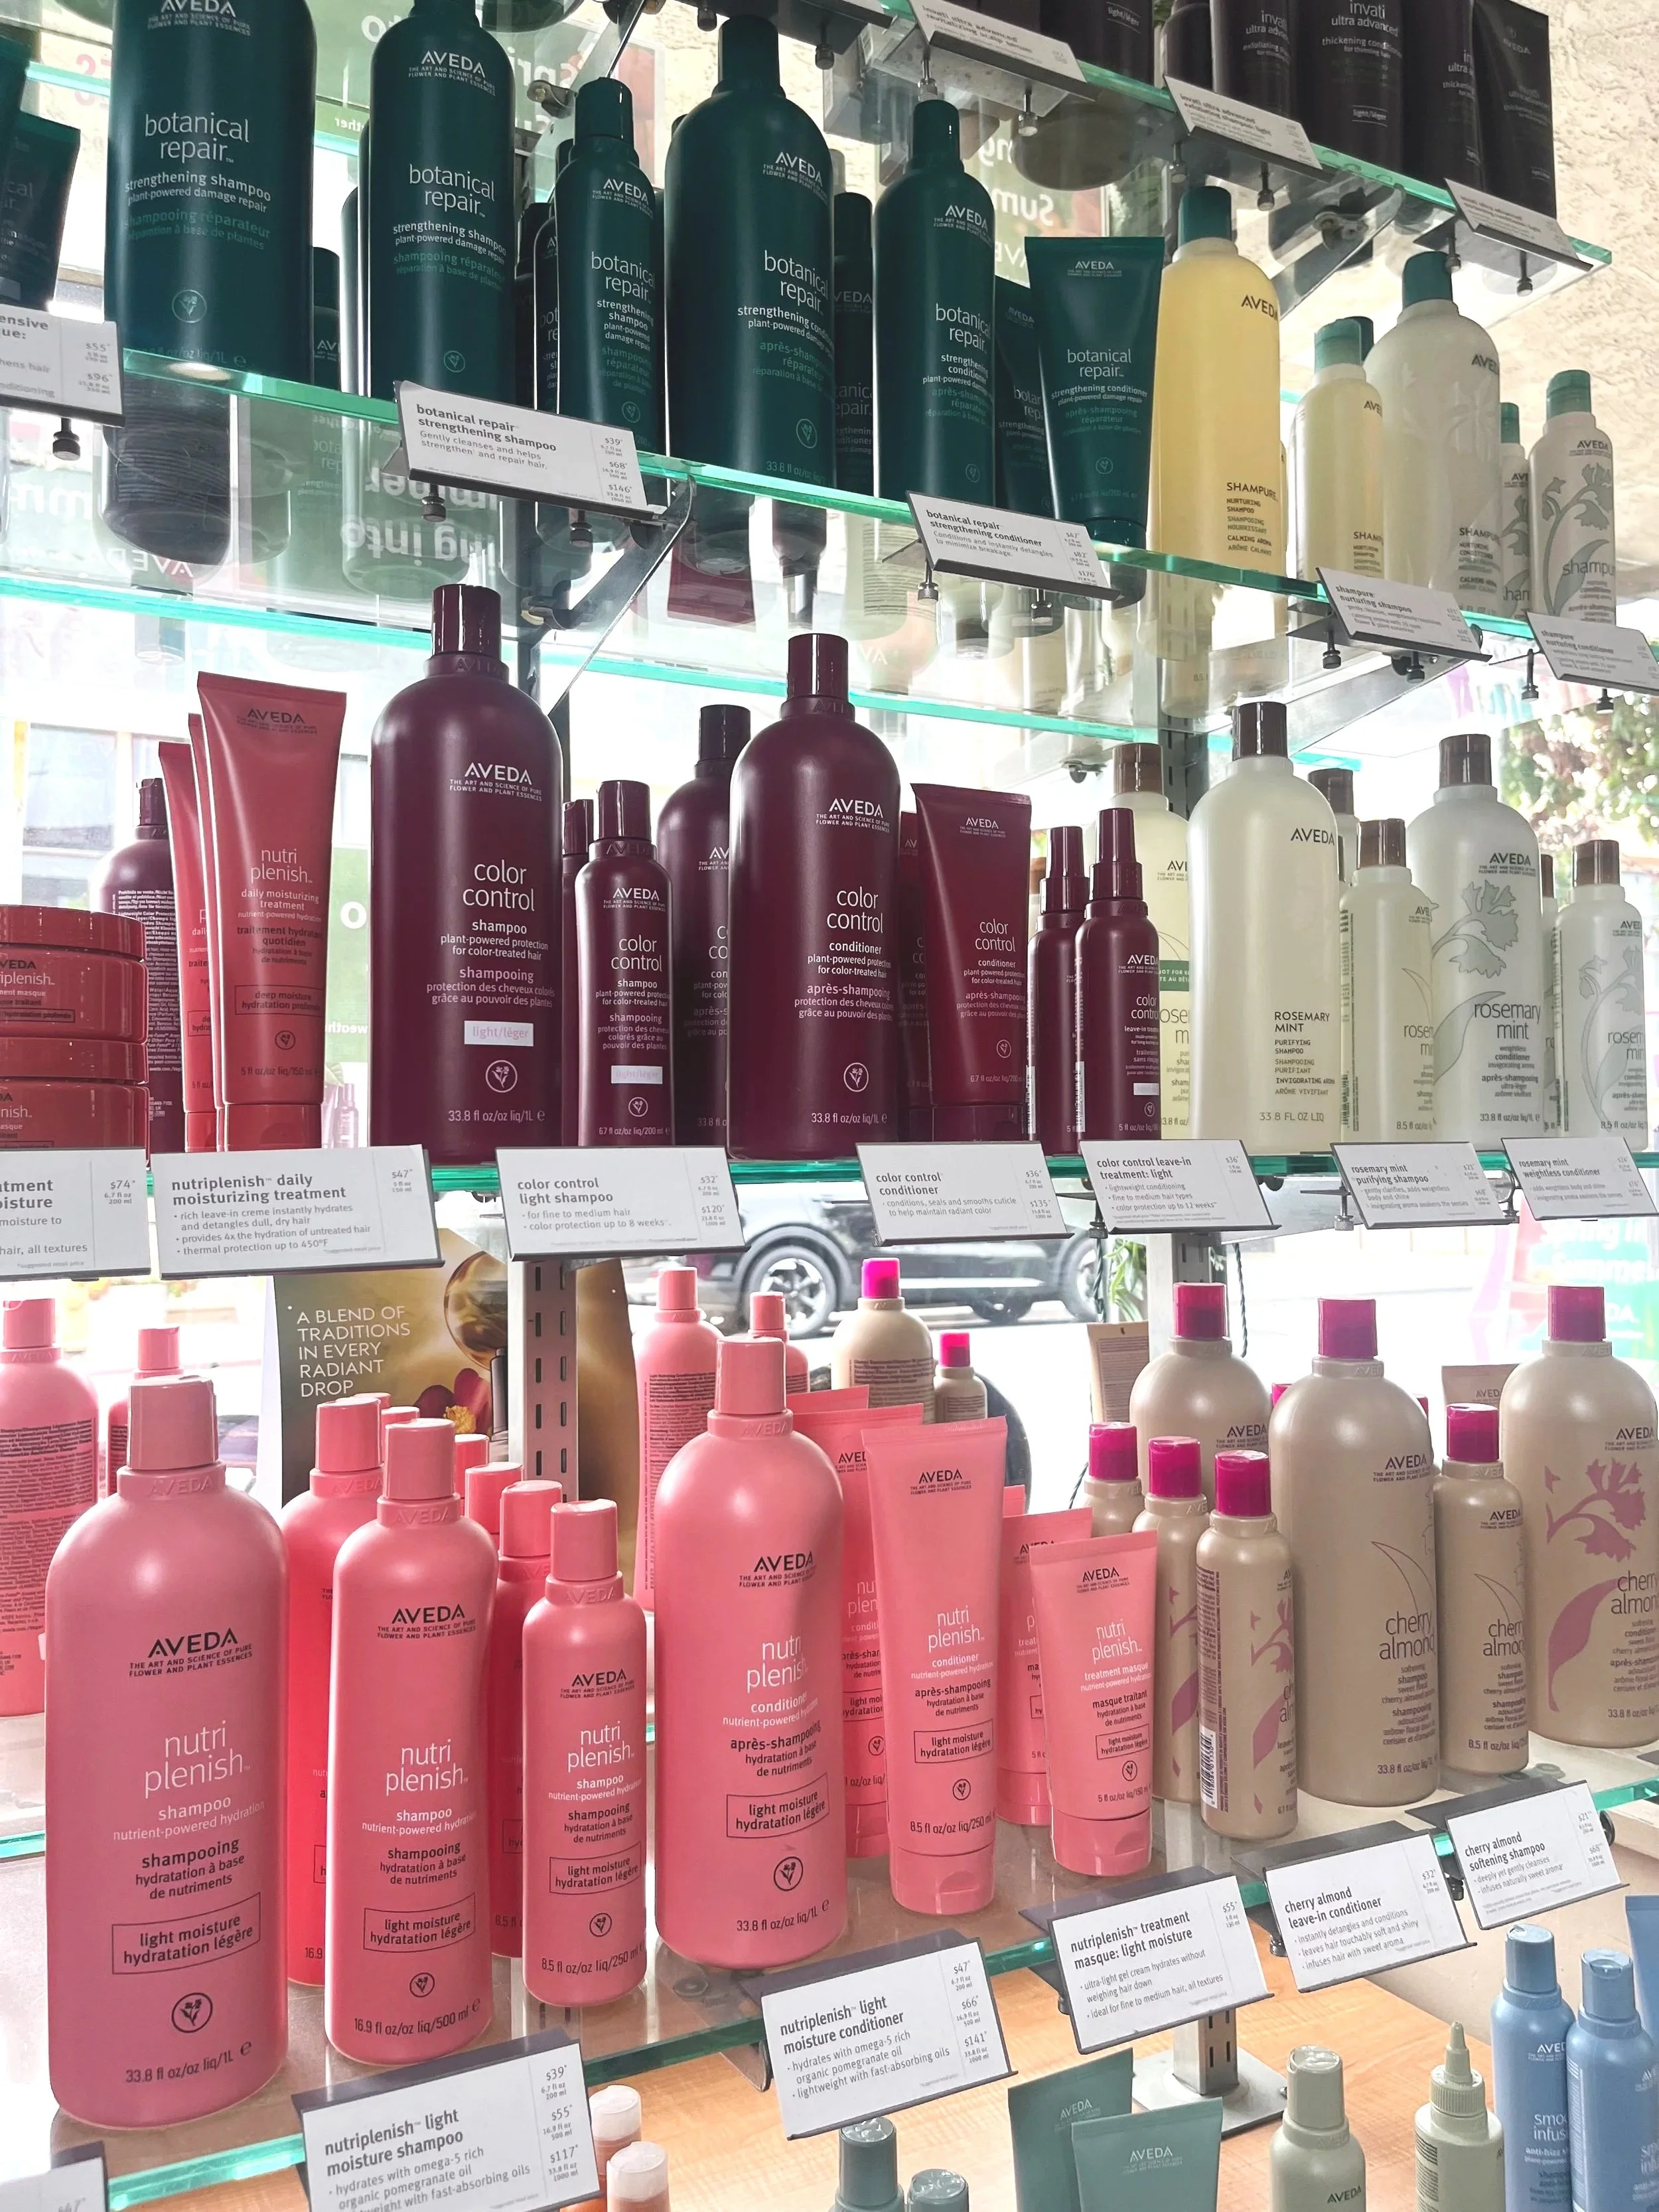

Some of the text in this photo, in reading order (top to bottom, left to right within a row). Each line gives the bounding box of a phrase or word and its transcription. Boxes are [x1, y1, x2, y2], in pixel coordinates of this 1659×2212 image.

[1349, 0, 1386, 20] invati
[1331, 15, 1398, 37] ultra advanced
[421, 51, 486, 78] AVEDA
[145, 112, 249, 143] botanical
[125, 171, 271, 201] strengthening shampoo
[409, 163, 495, 202] botanical
[764, 250, 829, 300] botanical
[1067, 348, 1132, 364] botanical
[416, 404, 475, 425] botanical
[419, 417, 557, 451] strengthening shampoo
[420, 430, 541, 461] Gently cleanses and helps
[1226, 498, 1262, 507] NURTURING
[926, 509, 972, 526] botanical
[930, 520, 1042, 547] strengthening conditioner
[1340, 596, 1413, 613] nurturing shampoo
[465, 762, 532, 785] AVEDA
[1290, 828, 1335, 846] AVEDA
[260, 848, 297, 864] nutri
[474, 859, 527, 884] color
[241, 889, 320, 904] daily moisturizing
[259, 899, 305, 911] treatment
[463, 887, 535, 911] control
[836, 885, 879, 909] color
[472, 919, 527, 935] shampoo
[826, 909, 883, 934] control
[979, 919, 1009, 934] color
[828, 940, 882, 955] conditioner
[975, 936, 1016, 952] control
[459, 966, 534, 984] shampooing
[1274, 1011, 1331, 1022] ROSEMARY
[1473, 1002, 1541, 1025] rosemary
[472, 1025, 529, 1039] light/léger
[1274, 1023, 1304, 1033] MINT
[1496, 1020, 1530, 1040] mint
[448, 1110, 470, 1122] 33.8
[482, 1110, 508, 1122] oz/oz
[1097, 1157, 1192, 1168] color control leave-in
[1351, 1163, 1408, 1174] rosemary mint
[1518, 1157, 1569, 1168] rosemary mint
[277, 1173, 313, 1187] daily
[518, 1177, 599, 1190] color control
[876, 1173, 902, 1183] color
[1100, 1169, 1173, 1179] treatment: light
[1356, 1175, 1429, 1185] purifying shampoo
[1523, 1168, 1601, 1179] weightless conditioner
[173, 1187, 346, 1206] moisturizing treatment
[520, 1193, 613, 1206] light shampoo
[879, 1185, 939, 1196] conditioner
[181, 1217, 311, 1231] and detangles dull, dry hair
[297, 1305, 405, 1324] A BLEND OF
[297, 1323, 411, 1342] TRADITIONS
[299, 1341, 382, 1360] IN EVERY
[300, 1359, 384, 1378] RADIANT
[301, 1380, 354, 1397] DROP
[754, 1550, 814, 1572] AVEDA
[1386, 1611, 1433, 1637] cherry
[147, 1627, 238, 1658] AVEDA
[1379, 1633, 1436, 1660] almond
[187, 1652, 220, 1664] SCIENCE
[235, 1643, 252, 1653] PURE
[129, 1668, 162, 1677] FLOWER
[187, 1660, 212, 1671] PLANT
[216, 1651, 252, 1666] ESSENCES
[1092, 1690, 1148, 1710] masque traitant
[165, 1720, 226, 1758] nutri
[581, 1720, 621, 1745] nutri
[401, 1739, 452, 1766] nutri
[159, 1797, 231, 1820] shampoo
[142, 1839, 240, 1869] shampooing
[1465, 1832, 1522, 1857] cherry almond
[1470, 1843, 1546, 1872] softening shampoo
[1285, 1886, 1352, 1913] cherry almond
[1141, 1911, 1190, 1933] treatment
[1289, 1897, 1382, 1929] leave-in conditioner
[140, 1916, 240, 1949] light moisture
[1074, 1929, 1192, 1970] masque: light moisture
[859, 1996, 888, 2015] light
[783, 2011, 904, 2055] moisture conditioner
[792, 2030, 910, 2072] hydrates with omega-5 rich
[425, 2108, 459, 2130] light
[326, 2132, 464, 2177] moisture shampoo
[1129, 2145, 1174, 2163] AVEDA
[1327, 2185, 1362, 2205] AVEDA
